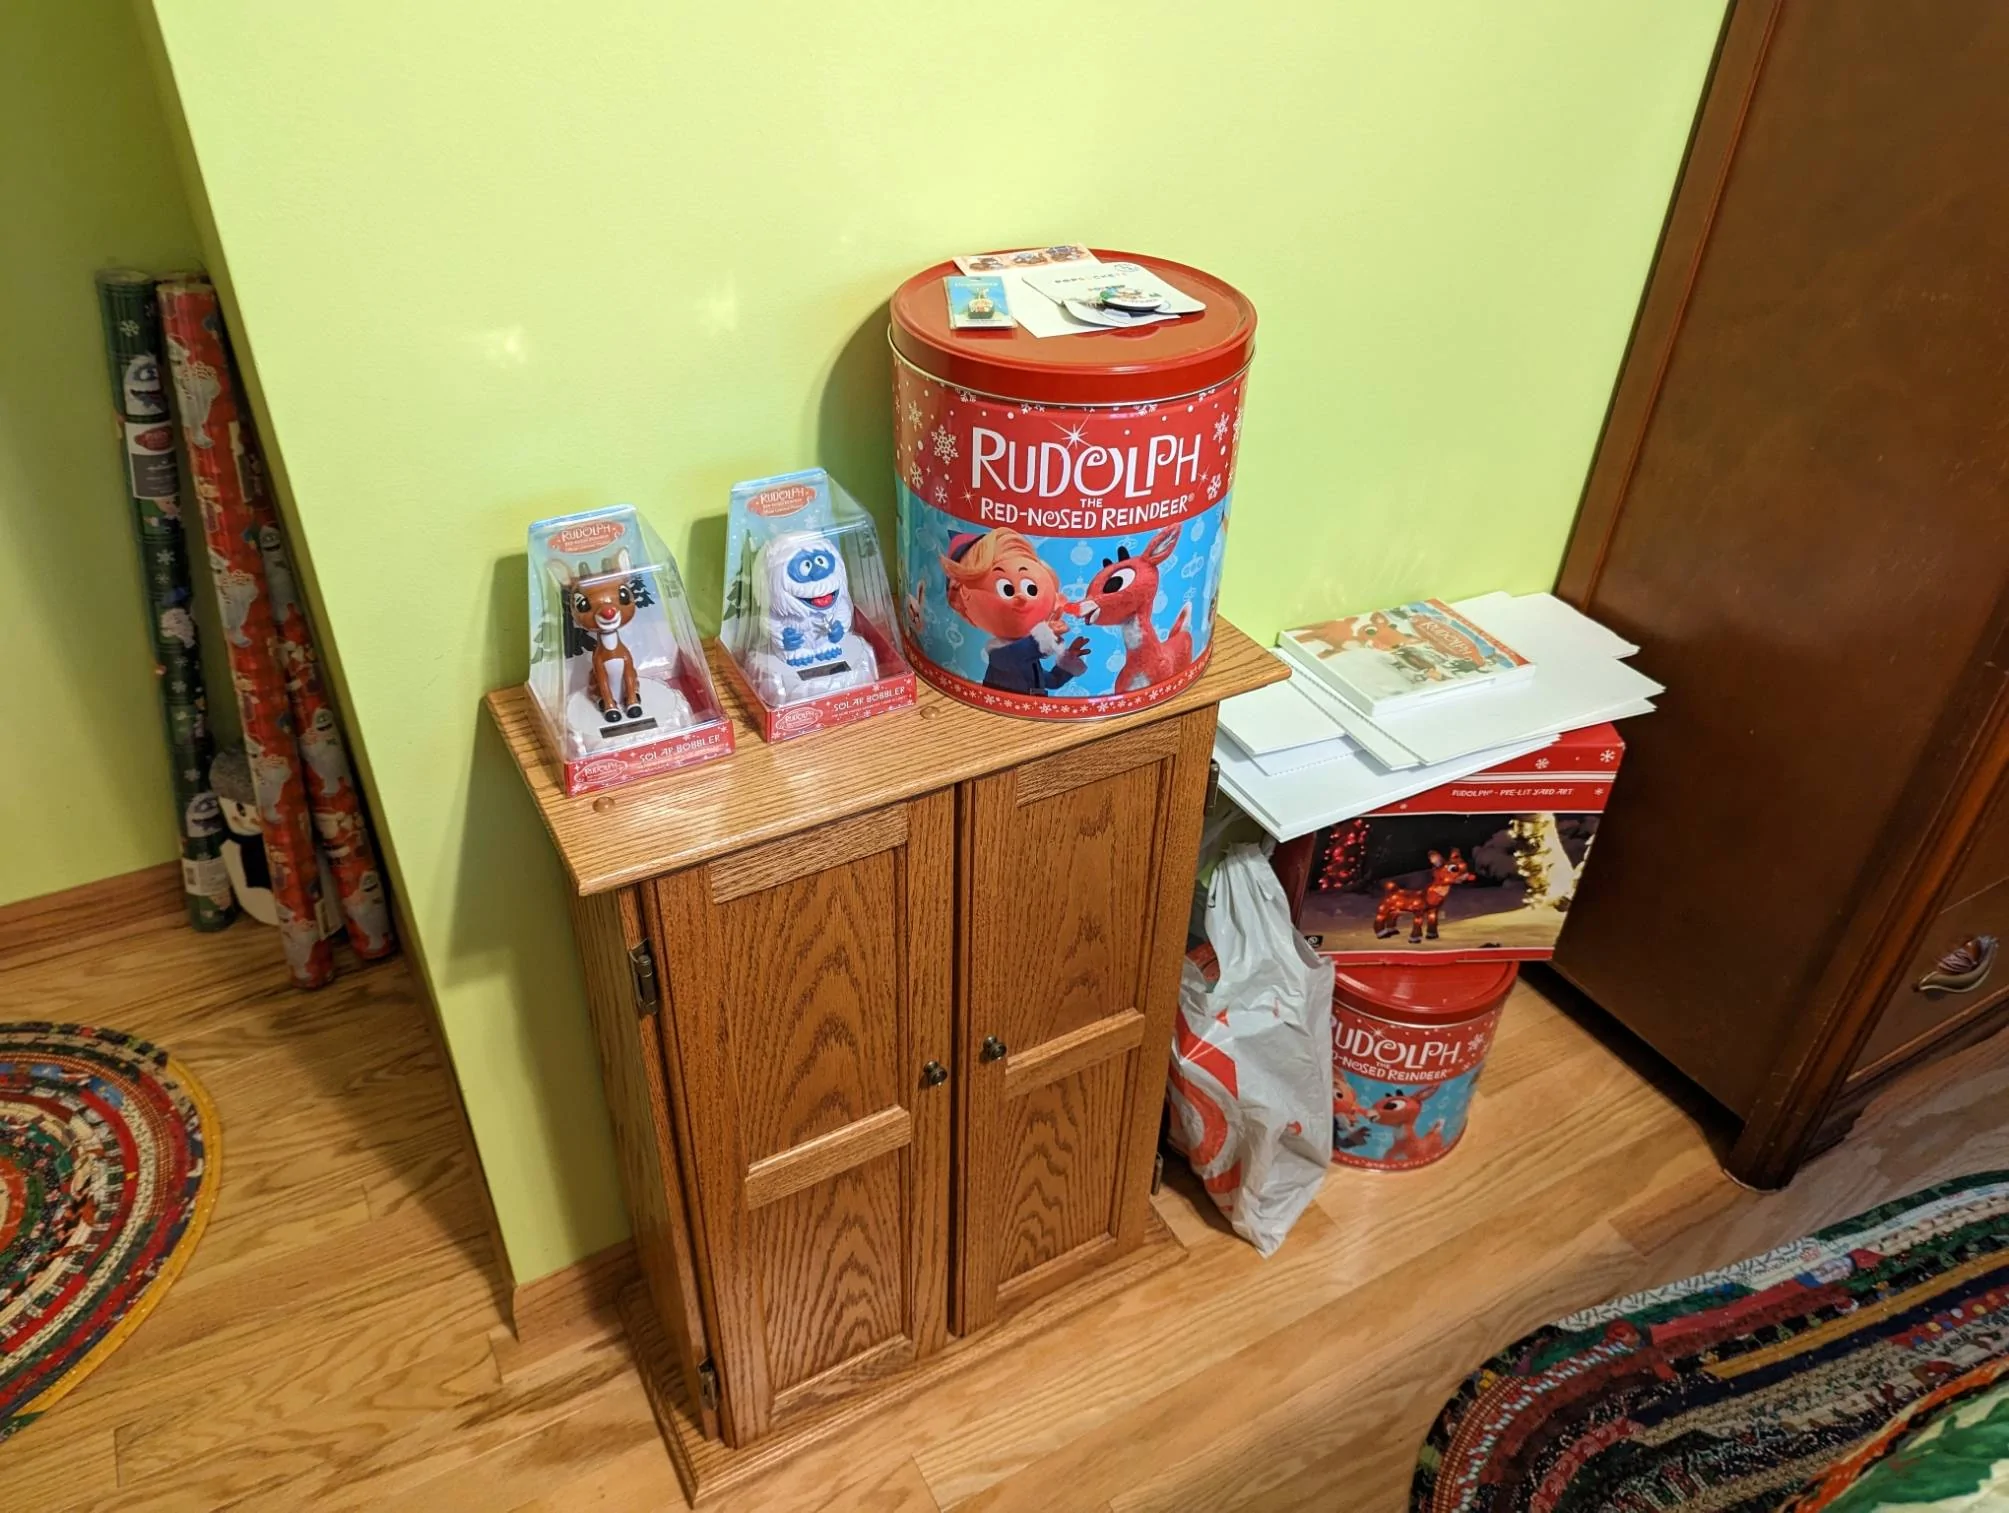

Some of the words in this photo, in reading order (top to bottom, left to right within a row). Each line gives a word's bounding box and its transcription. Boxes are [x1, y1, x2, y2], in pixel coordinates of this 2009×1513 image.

[971, 426, 1202, 498] RUDOLPH
[760, 487, 805, 505] RUDOLPH
[1080, 498, 1103, 508] THE
[981, 497, 1097, 530] RED-NOSED
[561, 523, 611, 542] RUDOLPH
[833, 696, 865, 712] SOLAR
[1330, 1015, 1461, 1069] UDOLPH
[1332, 1050, 1386, 1079] D-NOSED
[1375, 1061, 1391, 1070] THE
